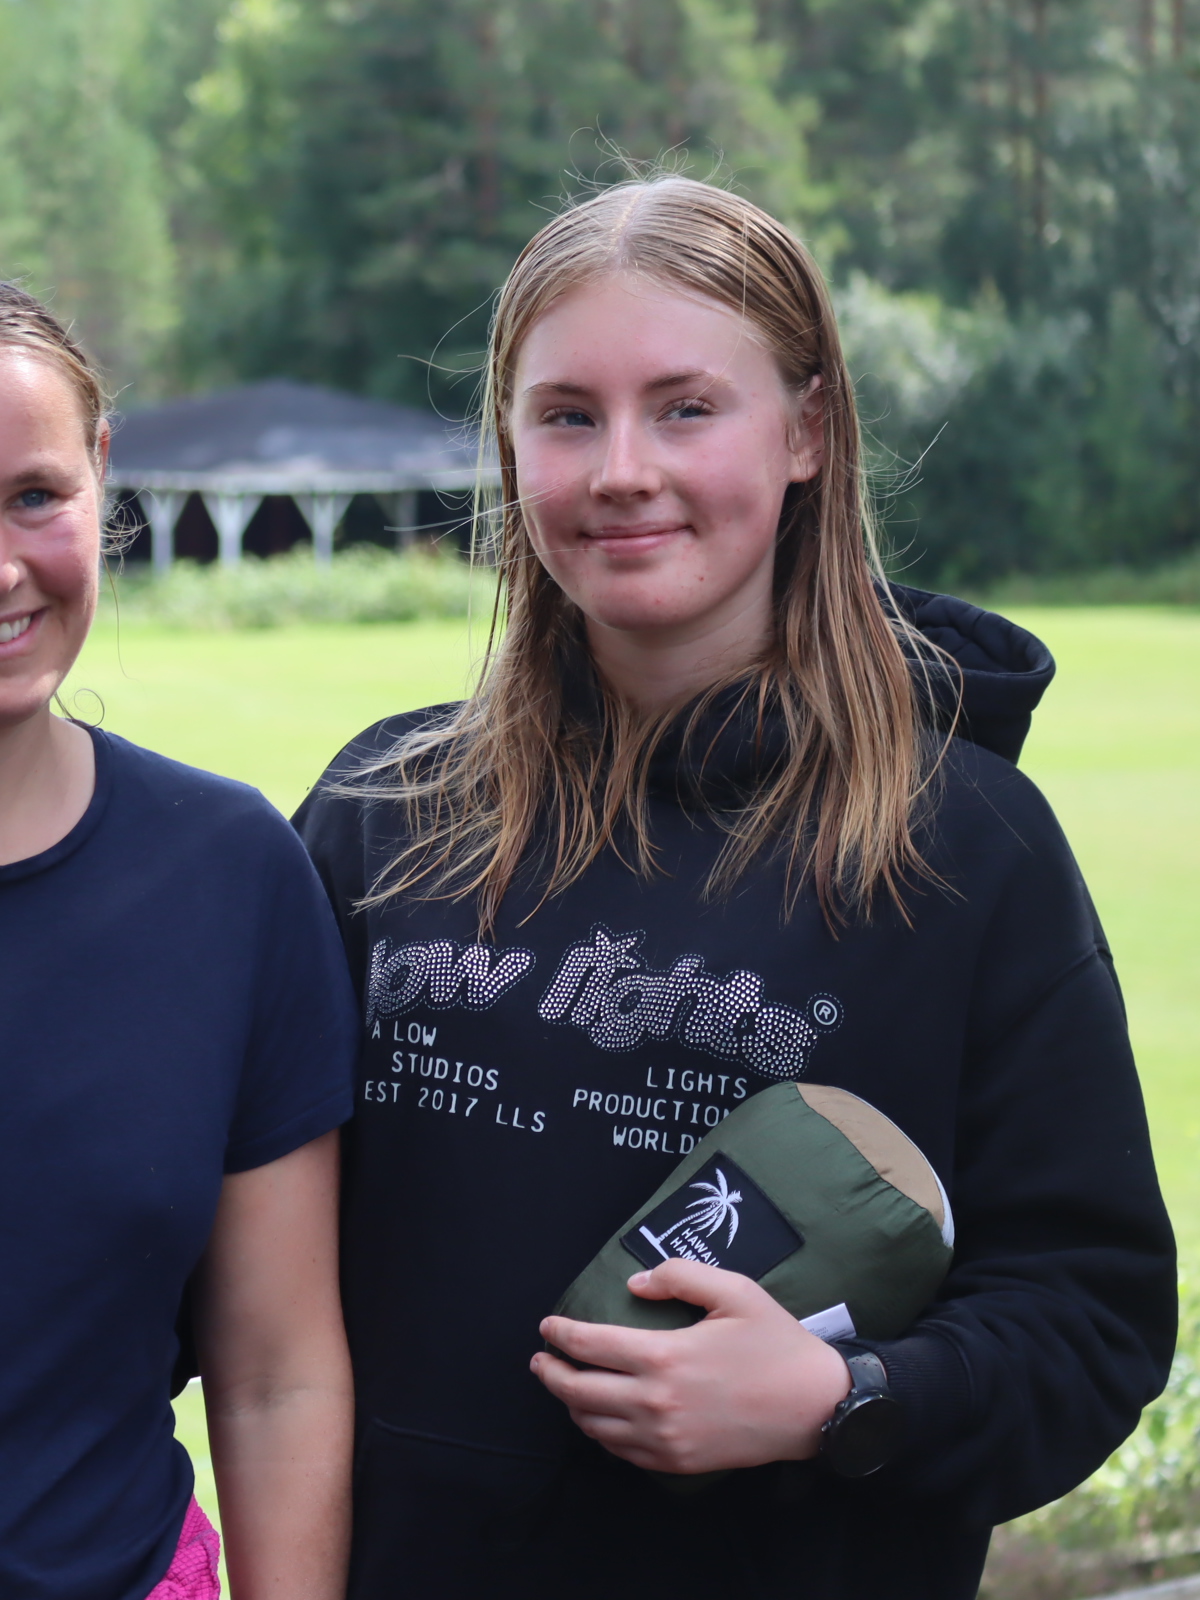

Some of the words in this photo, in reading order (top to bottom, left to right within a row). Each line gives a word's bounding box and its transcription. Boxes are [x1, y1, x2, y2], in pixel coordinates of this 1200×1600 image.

[372, 1020, 380, 1039] A
[394, 1021, 436, 1046] LOW
[392, 1051, 498, 1090] STUDIOS
[647, 1067, 747, 1099] LIGHTS
[365, 1081, 401, 1102] EST
[418, 1088, 478, 1116] 2017
[496, 1104, 546, 1132] LLS
[613, 1126, 703, 1154] WORLD
[670, 1236, 701, 1262] HAM
[681, 1227, 720, 1267] HAWAII
